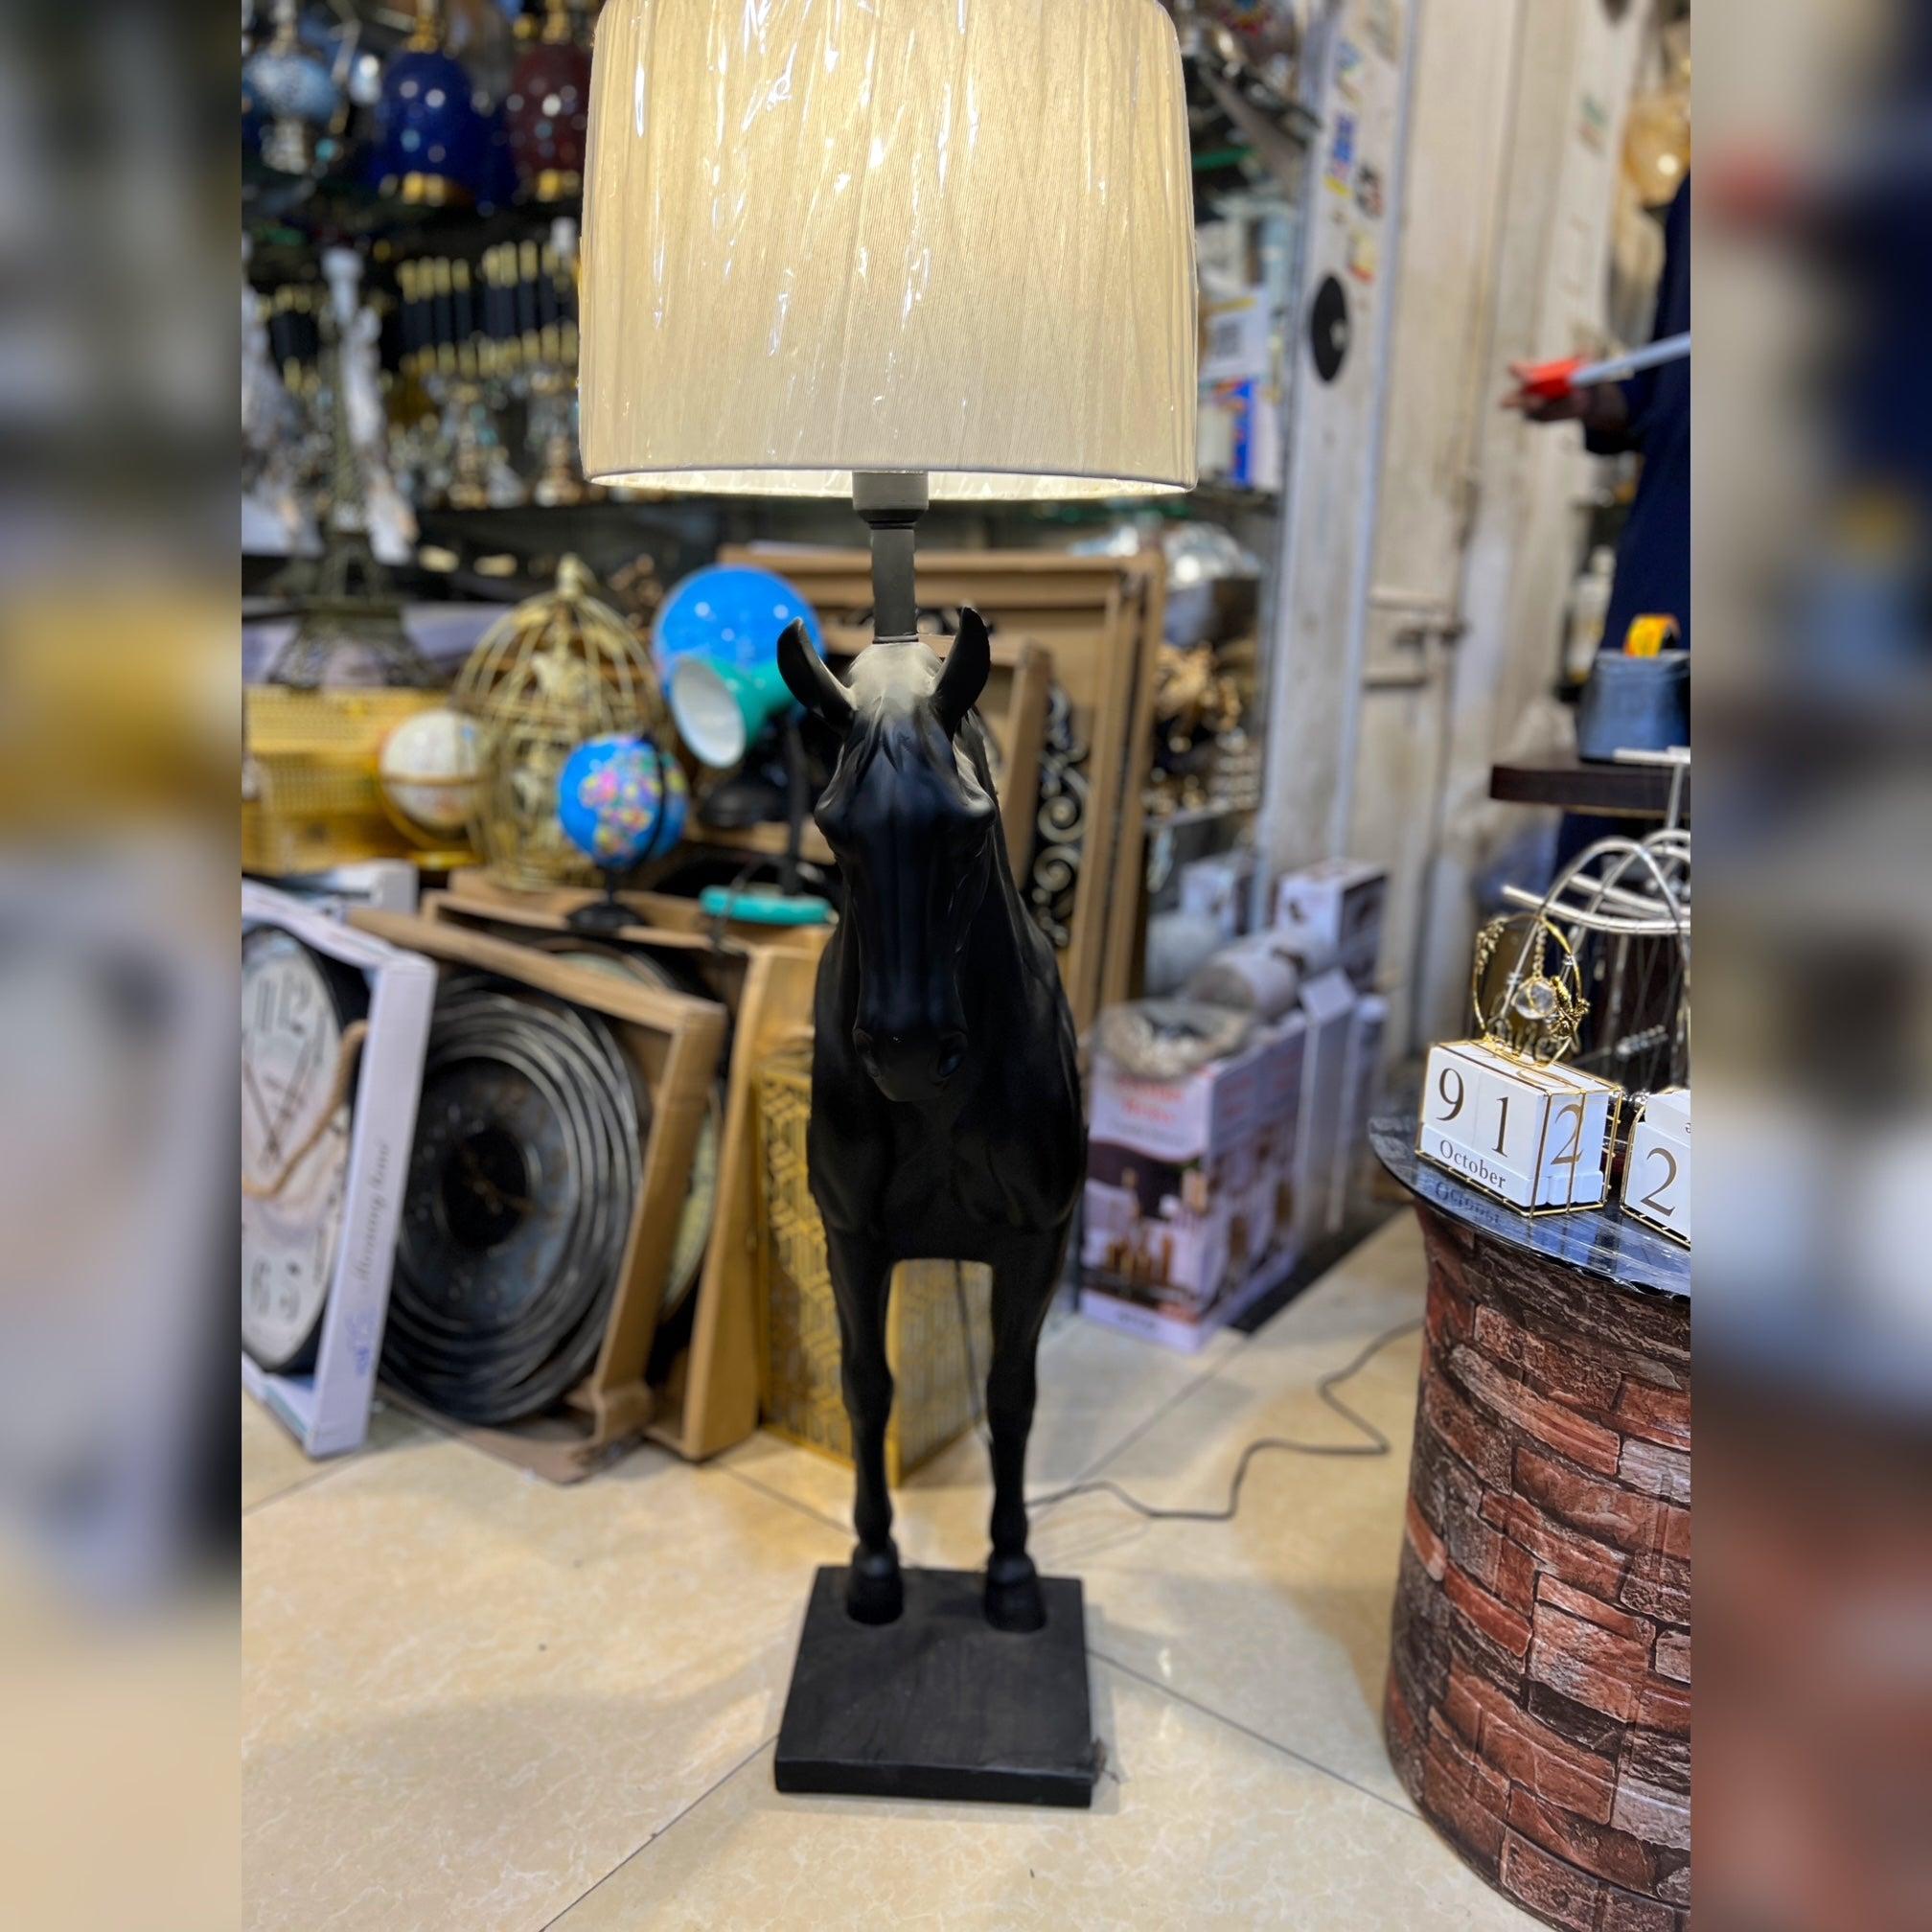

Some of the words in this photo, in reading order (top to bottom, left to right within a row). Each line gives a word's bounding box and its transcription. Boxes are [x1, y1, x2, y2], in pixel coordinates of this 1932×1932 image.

[1436, 1068, 1464, 1121] 9
[1491, 1096, 1509, 1159] 1
[1550, 1103, 1583, 1165] 2
[1439, 1139, 1506, 1189] October
[1640, 1147, 1677, 1217] 2
